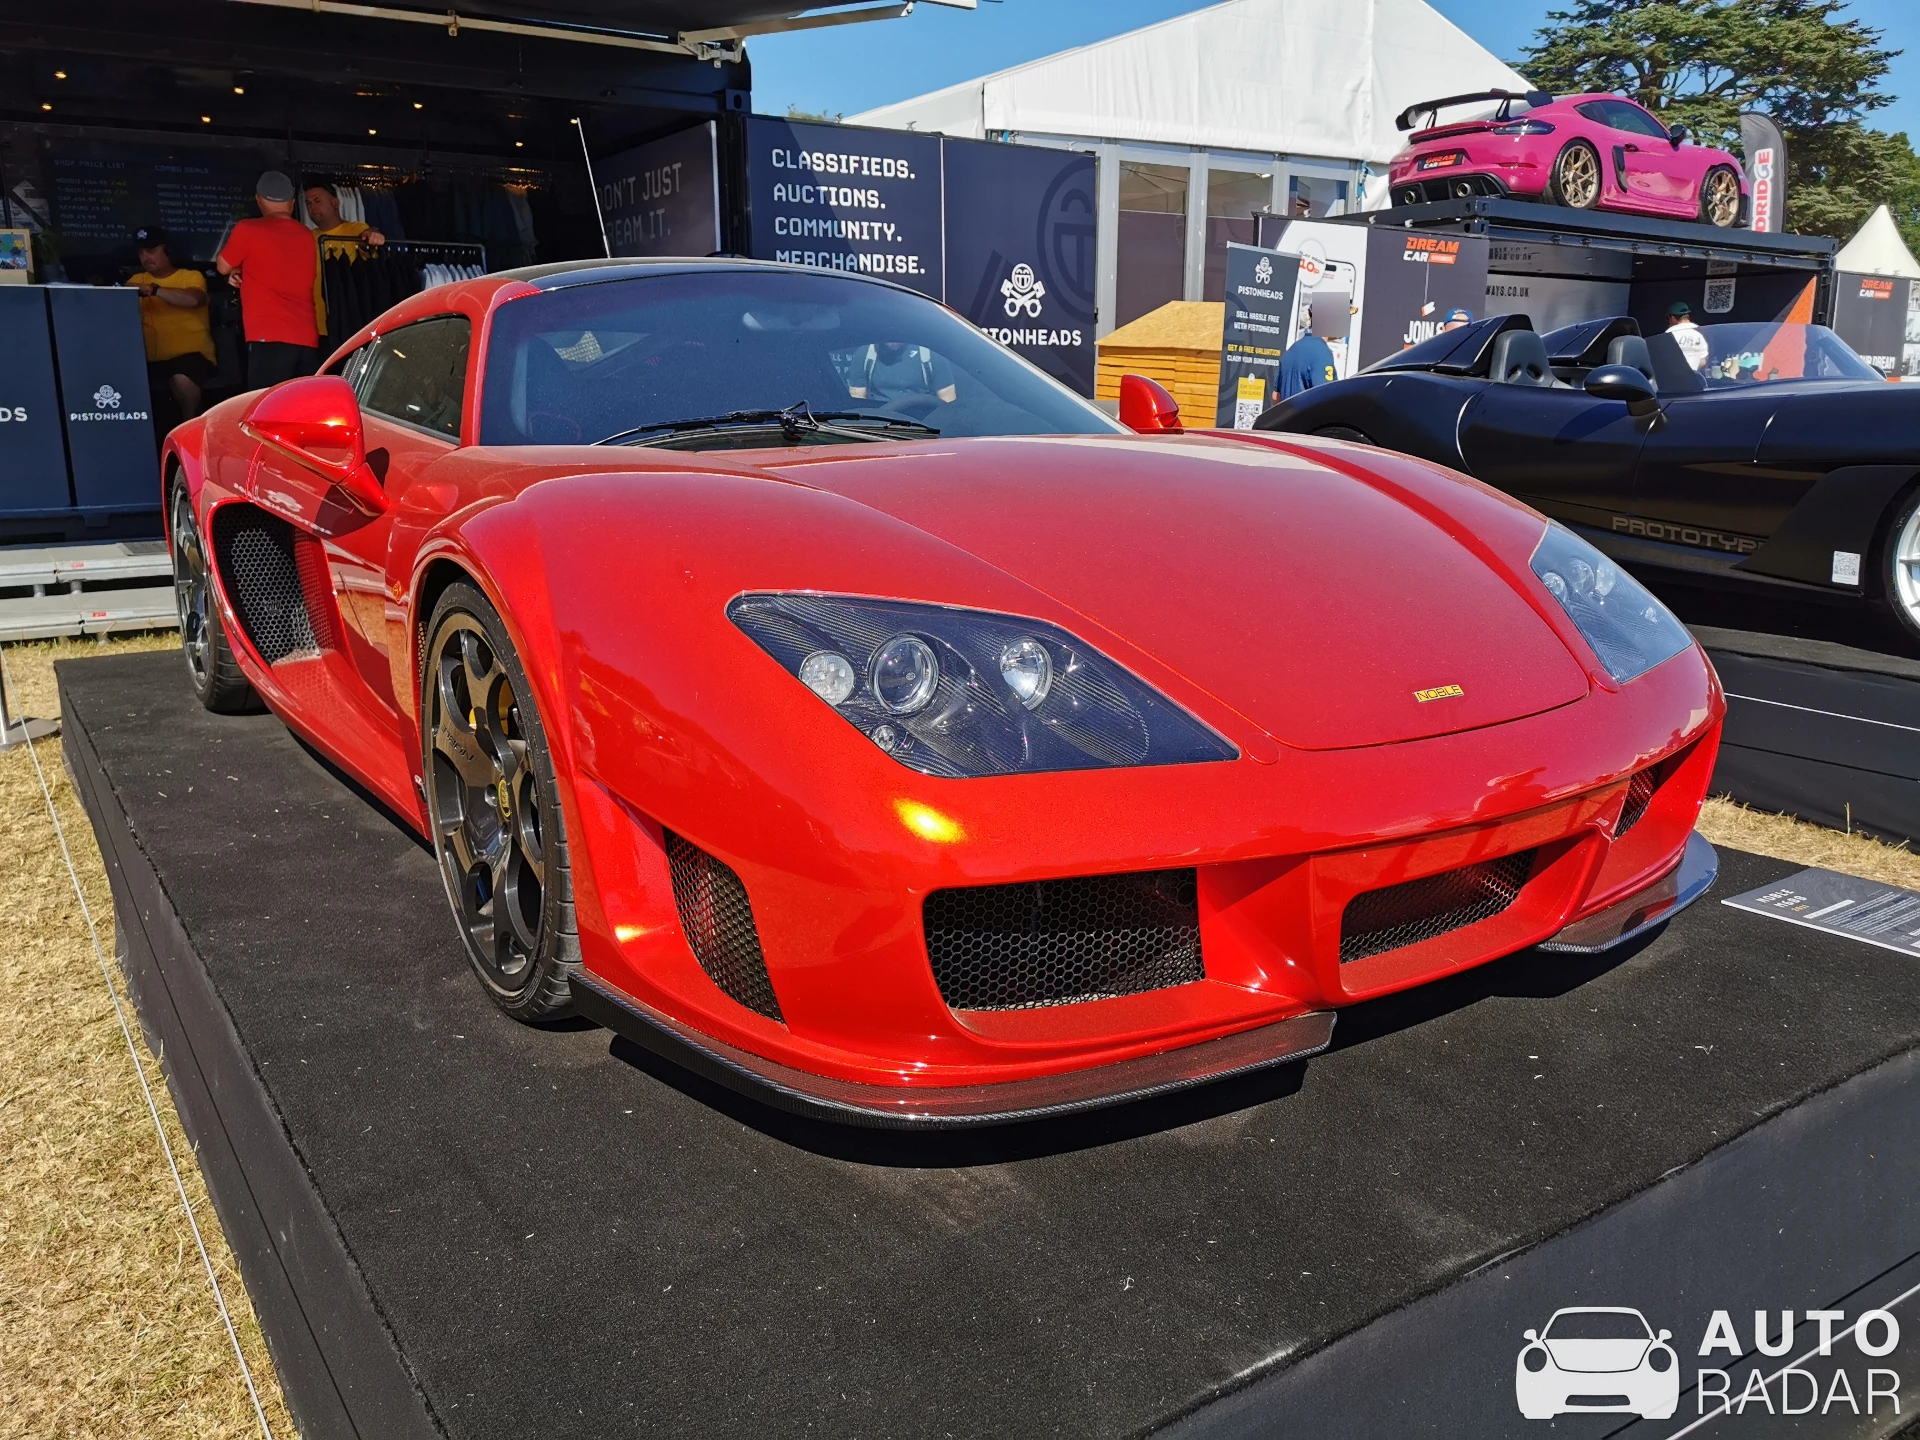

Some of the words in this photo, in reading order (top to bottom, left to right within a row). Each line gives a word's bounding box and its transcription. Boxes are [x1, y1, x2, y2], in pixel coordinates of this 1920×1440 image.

[771, 148, 916, 179] CLASSIFIEDS.
[642, 162, 682, 201] JUST
[772, 182, 886, 209] AUCTIONS.
[1755, 151, 1770, 232] DRIDGE
[606, 214, 643, 247] REAM
[649, 208, 671, 239] IT.
[774, 216, 903, 242] COMMUNITY.
[1405, 236, 1460, 253] DREAM
[775, 249, 926, 274] MERCHANDISE.
[1403, 250, 1429, 263] CAR
[1237, 285, 1284, 301] PISTONHEADS
[1485, 285, 1530, 298] WAYS.CO.UK
[1859, 289, 1875, 298] CAR
[1861, 279, 1894, 291] DREAM
[1236, 310, 1249, 319] SELL
[1267, 314, 1280, 323] FREE
[980, 327, 1082, 346] TONHEADS
[1403, 320, 1435, 344] JOIN
[1324, 365, 1334, 381] 3
[70, 411, 148, 422] PISTONHEADS
[1612, 516, 1765, 553] PROTOTYP
[1416, 685, 1462, 701] NOBLE
[1755, 888, 1795, 903] NOBLE
